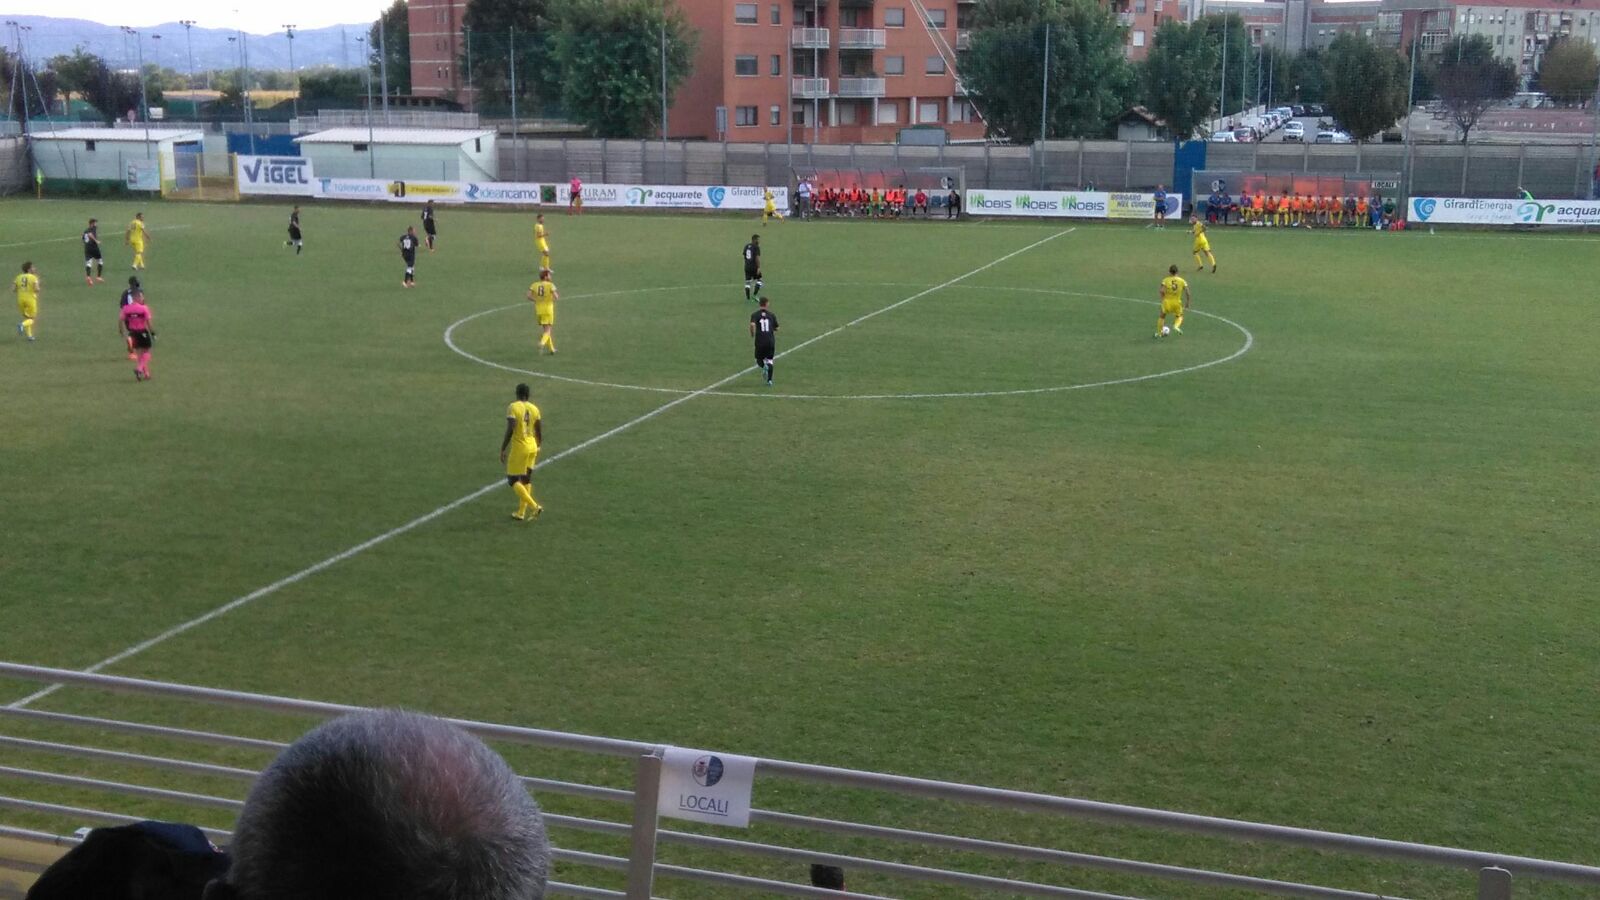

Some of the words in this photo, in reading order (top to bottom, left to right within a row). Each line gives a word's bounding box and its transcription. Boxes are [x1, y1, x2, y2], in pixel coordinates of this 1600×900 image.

[655, 191, 702, 201] acquarete
[976, 200, 1012, 208] NOBIS
[1022, 201, 1058, 210] NOBIS
[1068, 202, 1105, 211] NOBIS
[759, 318, 770, 332] 11
[679, 794, 729, 814] LOCALI
